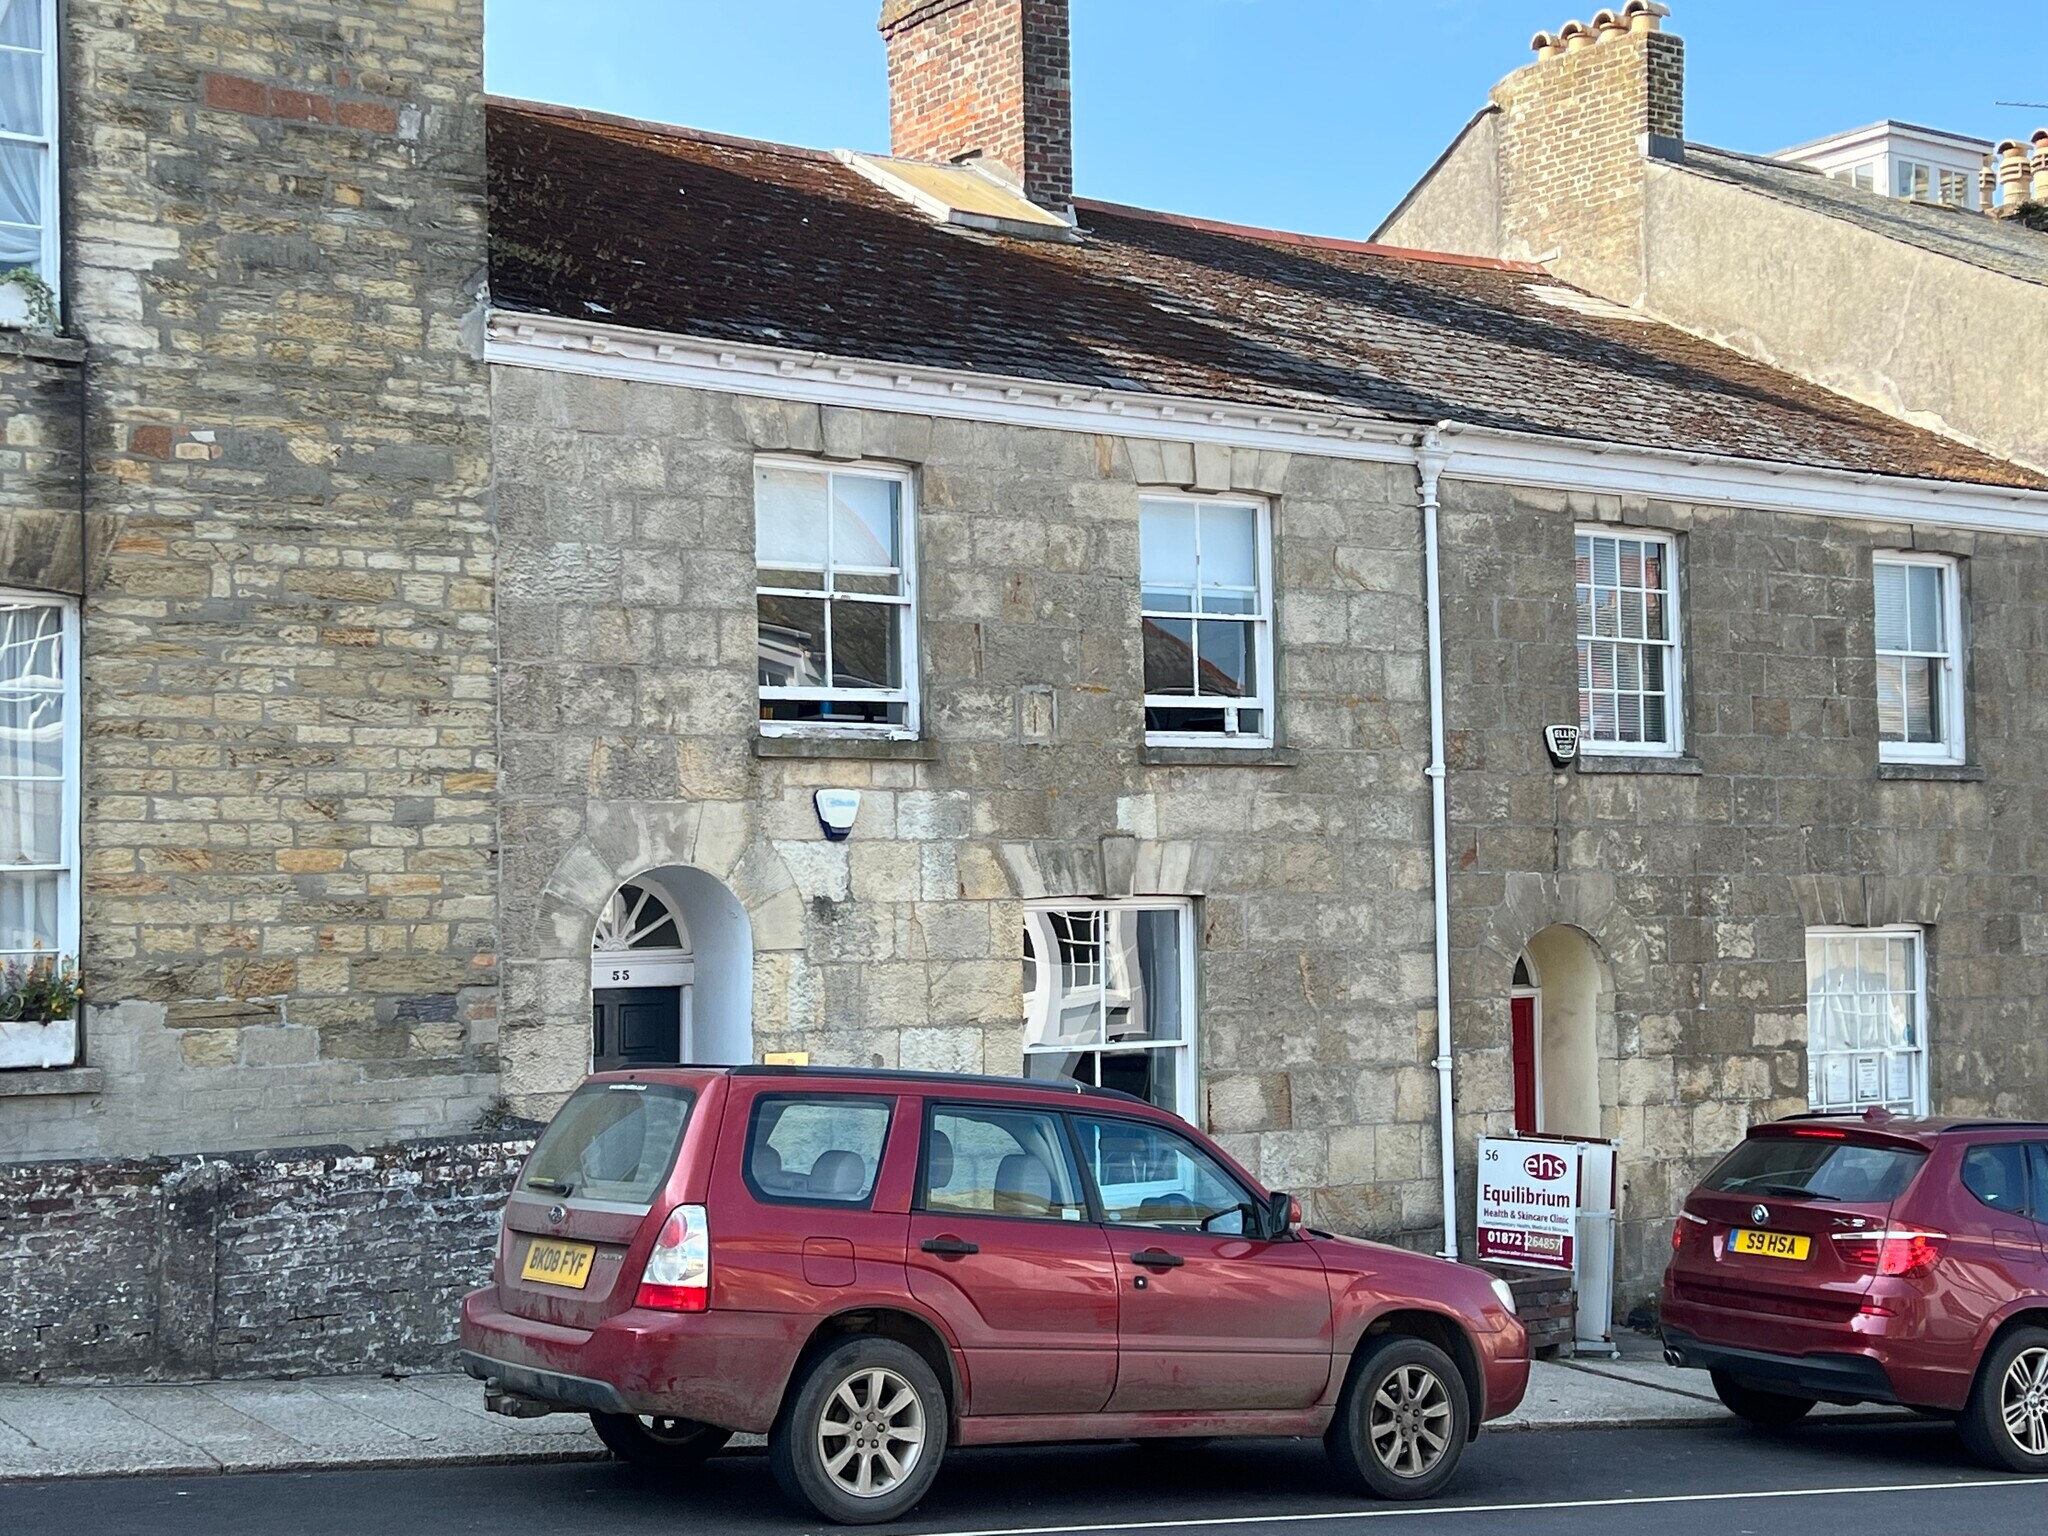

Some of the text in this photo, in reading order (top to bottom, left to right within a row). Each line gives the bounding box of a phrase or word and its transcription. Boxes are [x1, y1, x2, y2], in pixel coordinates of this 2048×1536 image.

[1555, 730, 1576, 739] ELLIS
[1485, 1149, 1499, 1162] 56
[1524, 1154, 1565, 1176] ehs
[1483, 1184, 1570, 1208] Equilibrium
[1483, 1207, 1569, 1225] Health & Skincare Clinic
[1487, 1230, 1560, 1250] 01872 264857
[1746, 1232, 1796, 1255] S9 HSA
[529, 1247, 587, 1276] BK08 FYF
